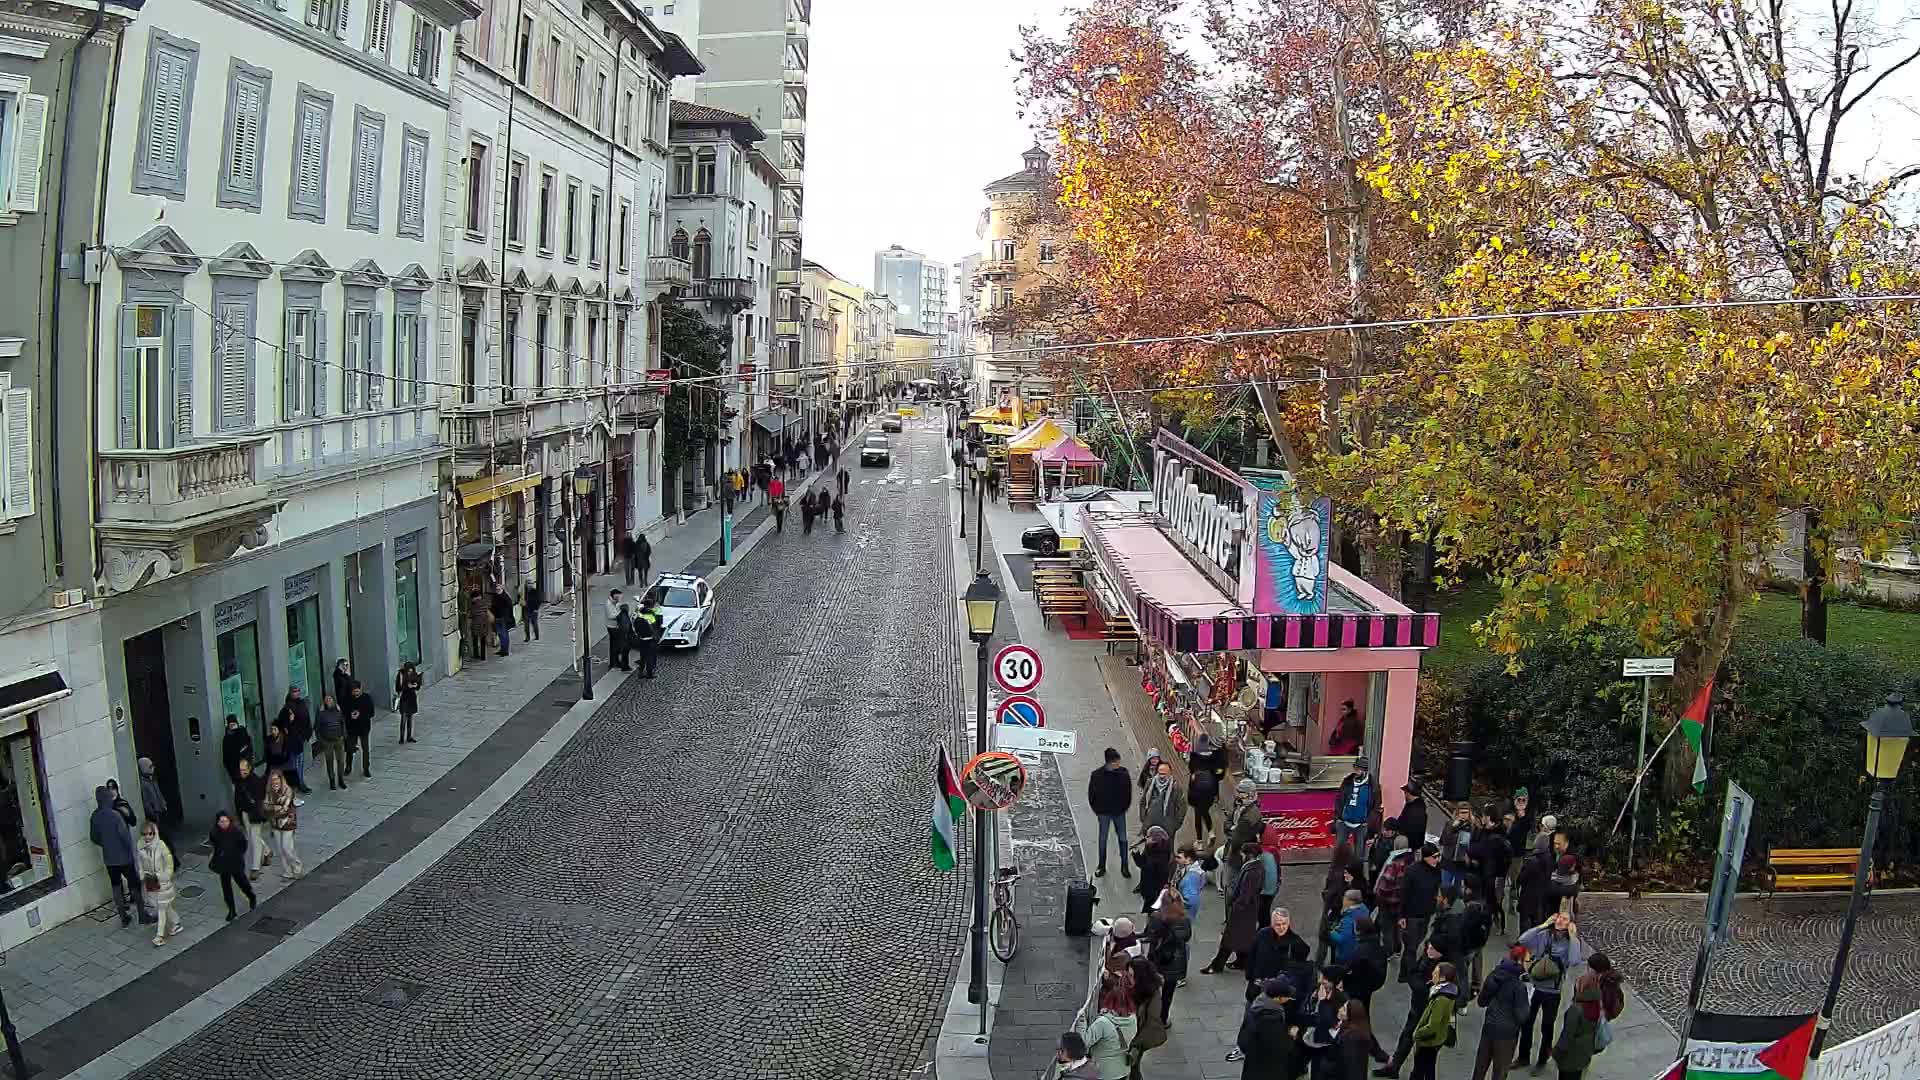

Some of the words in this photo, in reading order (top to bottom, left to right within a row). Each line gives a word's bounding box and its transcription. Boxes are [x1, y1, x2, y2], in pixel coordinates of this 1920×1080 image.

[1162, 457, 1234, 571] Golosone
[1005, 658, 1033, 680] 30
[1038, 737, 1069, 748] Dante
